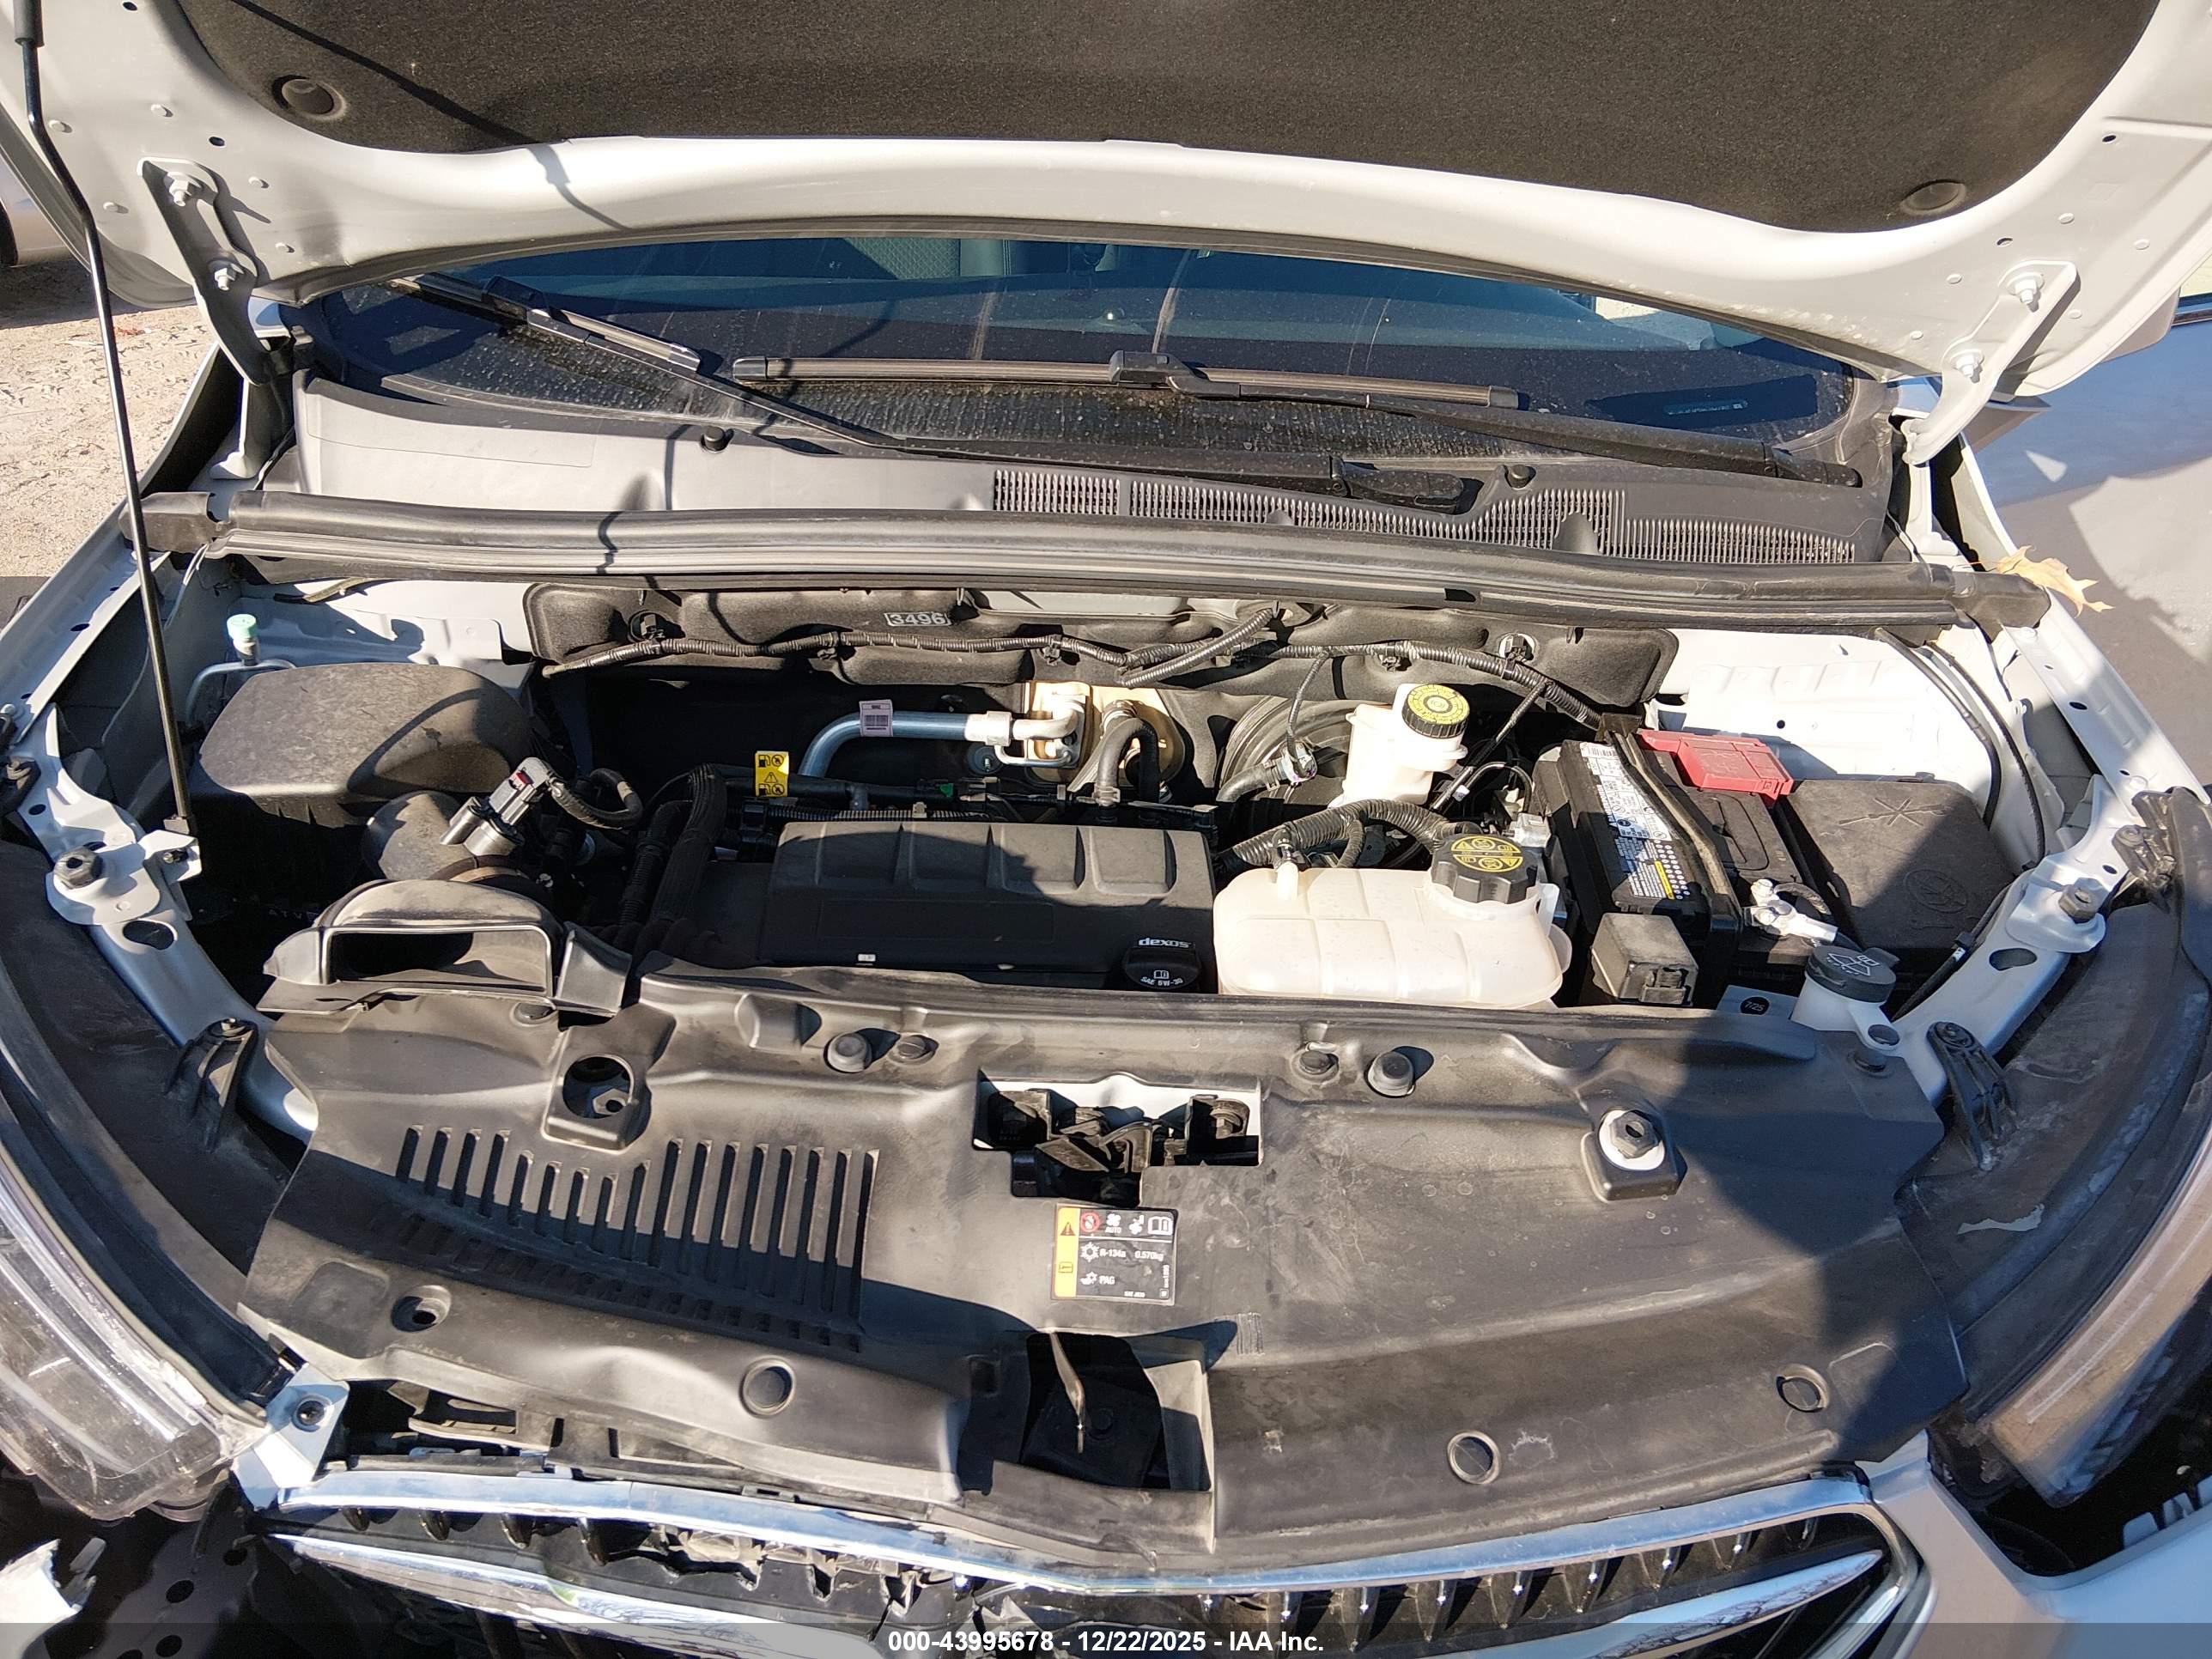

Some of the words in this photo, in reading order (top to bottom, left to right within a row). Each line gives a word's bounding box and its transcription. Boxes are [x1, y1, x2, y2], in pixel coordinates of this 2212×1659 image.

[890, 612, 945, 625] 3496
[1139, 938, 1190, 948] dexos
[1140, 976, 1156, 985] SAE
[1099, 1249, 1126, 1257] R-134a
[1099, 1275, 1115, 1285] PAG
